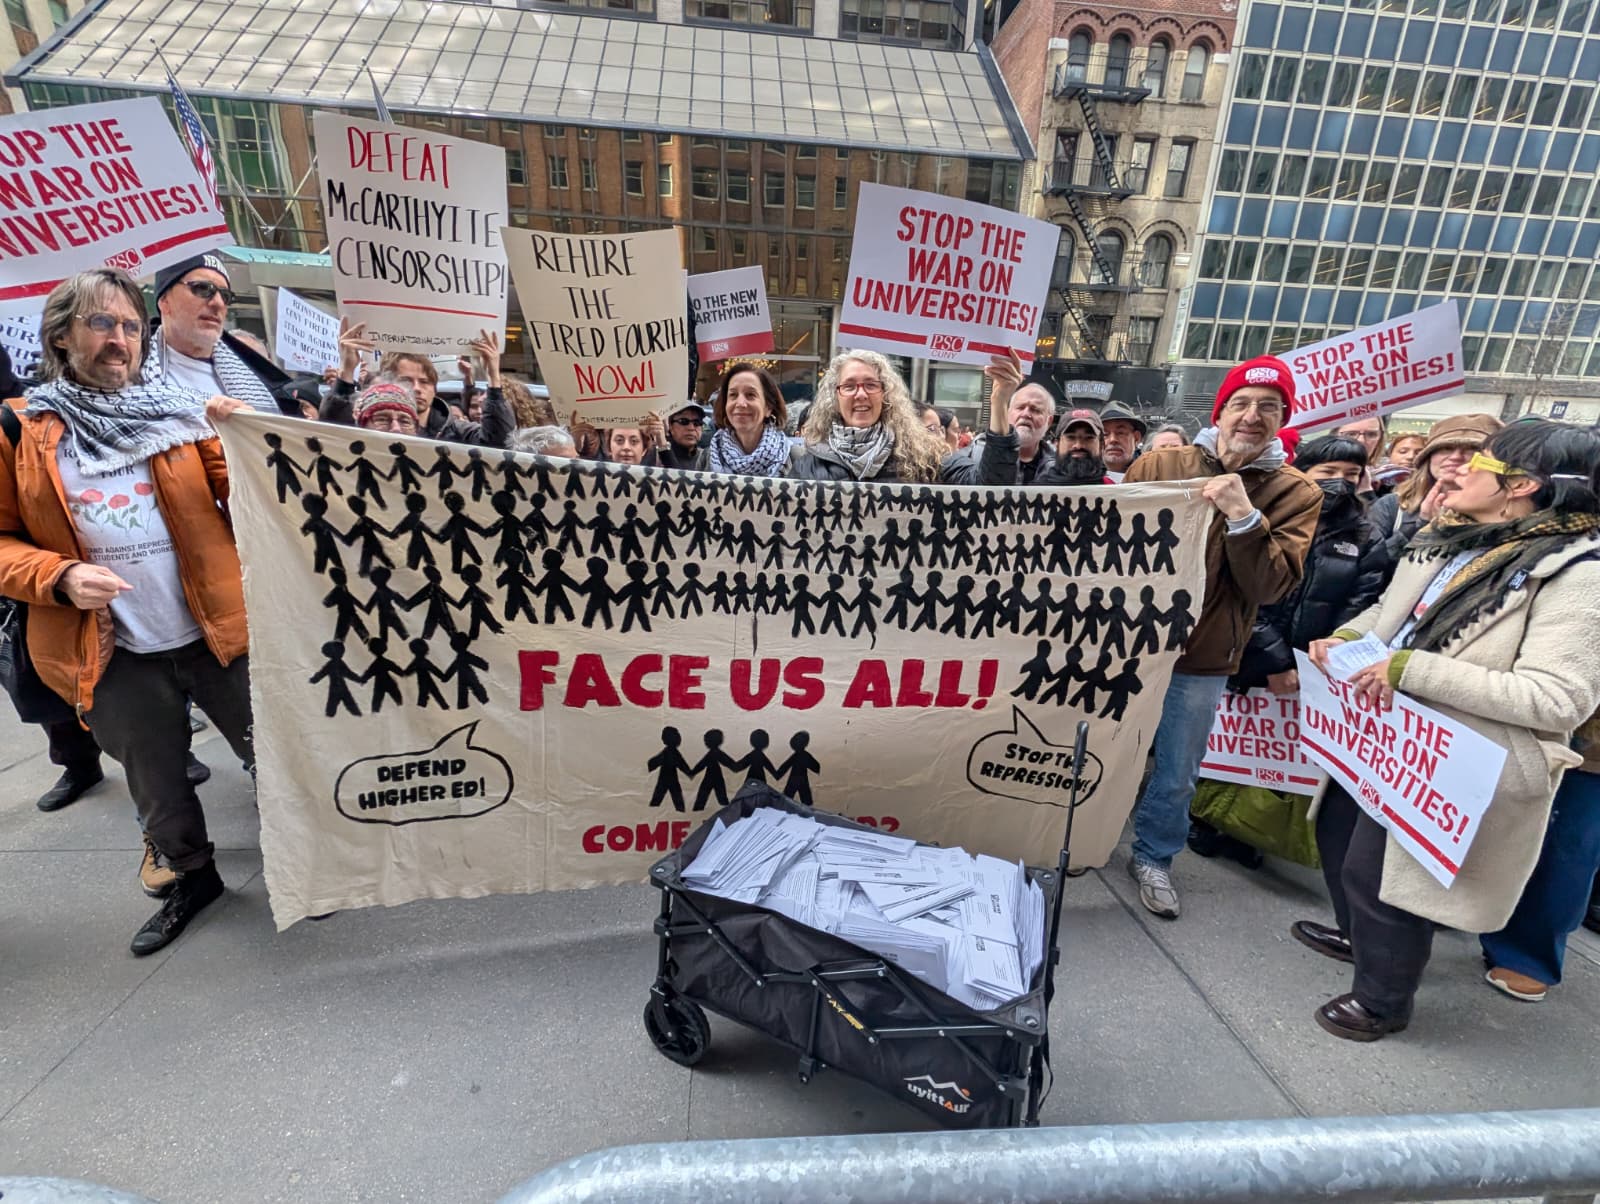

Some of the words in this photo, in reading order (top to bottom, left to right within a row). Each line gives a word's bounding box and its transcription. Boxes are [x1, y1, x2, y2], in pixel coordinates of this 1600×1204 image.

[0, 130, 47, 168] OP
[48, 118, 132, 159] THE
[347, 126, 452, 189] DEFEAT
[90, 157, 143, 194] ON
[0, 184, 209, 260] NIVERSITIES!
[327, 179, 501, 248] McCARTHYITE
[897, 206, 974, 250] STOP
[981, 221, 1026, 264] THE
[336, 237, 505, 299] CENSORSHIP!
[531, 233, 637, 278] REHIRE
[908, 247, 974, 290] WAR
[979, 260, 1013, 296] ON
[562, 286, 621, 320] THE
[693, 298, 702, 310] O
[703, 294, 729, 309] THE
[730, 288, 758, 305] NEW
[695, 303, 760, 325] ARTHYISM!
[853, 277, 1038, 336] UNIVERSITIES!
[308, 334, 337, 350] AGAINS
[530, 320, 605, 359] FIRED
[931, 334, 965, 352] PSC
[931, 350, 958, 359] CUNY
[1293, 341, 1355, 375] STOP
[1360, 322, 1415, 354] THE
[1249, 367, 1278, 379] PSC
[1294, 352, 1456, 415] NIVERSITIES!
[1307, 359, 1366, 389] WAR
[1371, 346, 1409, 372] ON
[1350, 401, 1378, 417] PSC
[94, 552, 130, 561] STUDENTS
[131, 550, 148, 559] AND
[150, 545, 177, 555] WORKE
[105, 544, 136, 553] AGAINST
[138, 539, 174, 549] REPRESS
[518, 649, 710, 711] FACE
[729, 656, 825, 711] US
[841, 658, 1000, 710] ALL!
[1216, 694, 1269, 715] TOP
[1275, 698, 1300, 719] TH
[1327, 674, 1393, 718] STOP
[1398, 705, 1453, 760] THE
[1220, 714, 1276, 738] WAR
[1284, 721, 1300, 740] O
[1341, 701, 1397, 753] WAR
[1402, 738, 1438, 782] ON
[377, 759, 466, 782] DEFEND
[1005, 743, 1054, 765] STOP
[980, 761, 1093, 793] REPRESSION!
[1256, 768, 1284, 783] PSC
[1305, 704, 1470, 845] UNIVERSITIES!
[358, 785, 446, 810] HIGHER
[452, 777, 485, 798] ED!
[1360, 779, 1383, 809] PSC
[582, 821, 692, 854] COME
